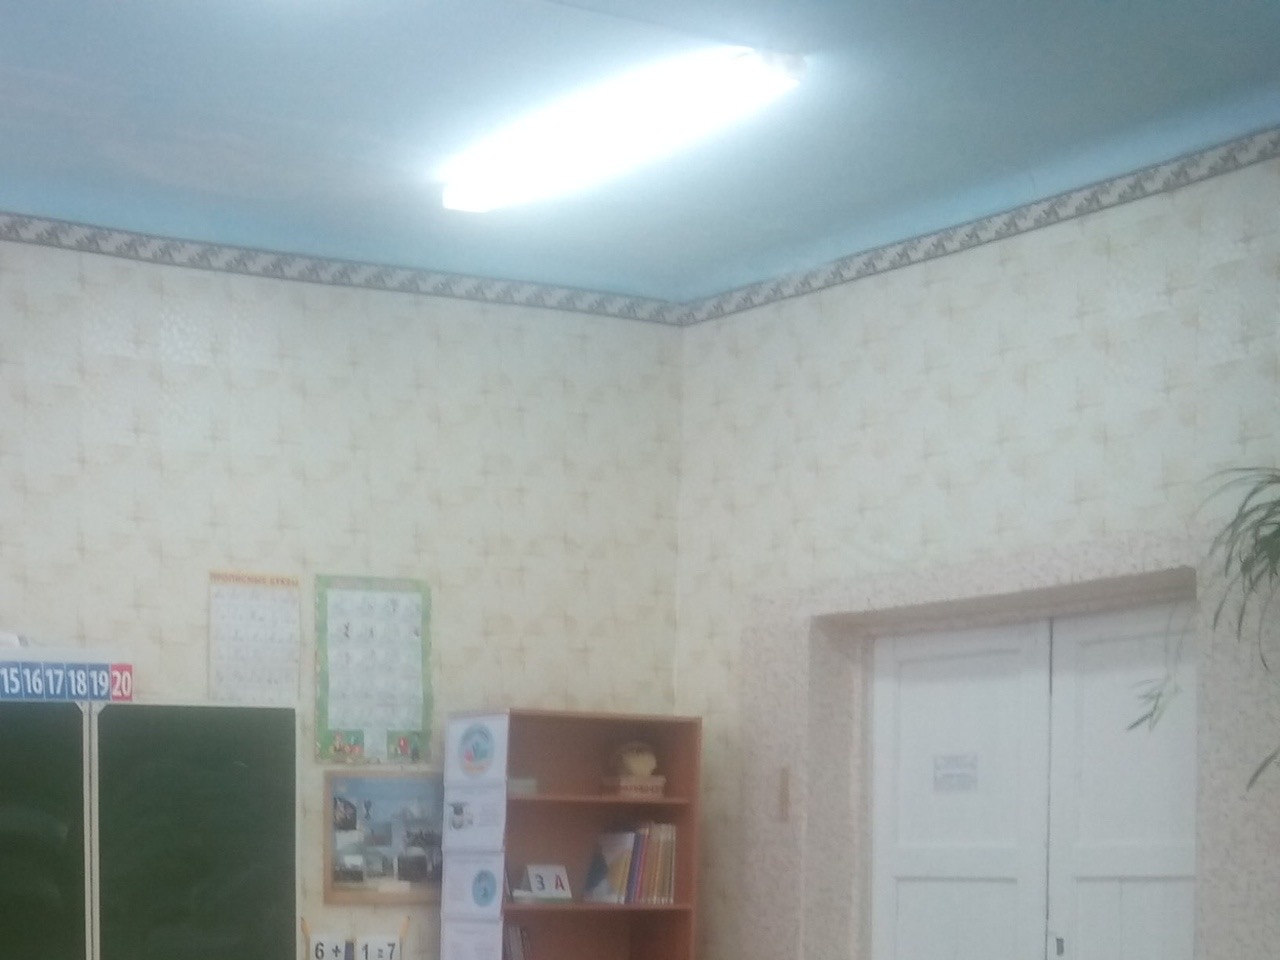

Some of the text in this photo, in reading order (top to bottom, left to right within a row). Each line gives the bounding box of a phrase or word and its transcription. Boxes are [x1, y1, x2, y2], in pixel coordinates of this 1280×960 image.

[0, 667, 19, 695] 15
[23, 667, 42, 695] 16
[45, 668, 64, 696] 17
[69, 668, 87, 696] 18
[90, 668, 109, 696] 19
[112, 668, 131, 697] 20
[315, 941, 324, 960] 6
[361, 943, 368, 960] 1
[387, 942, 396, 960] 7
